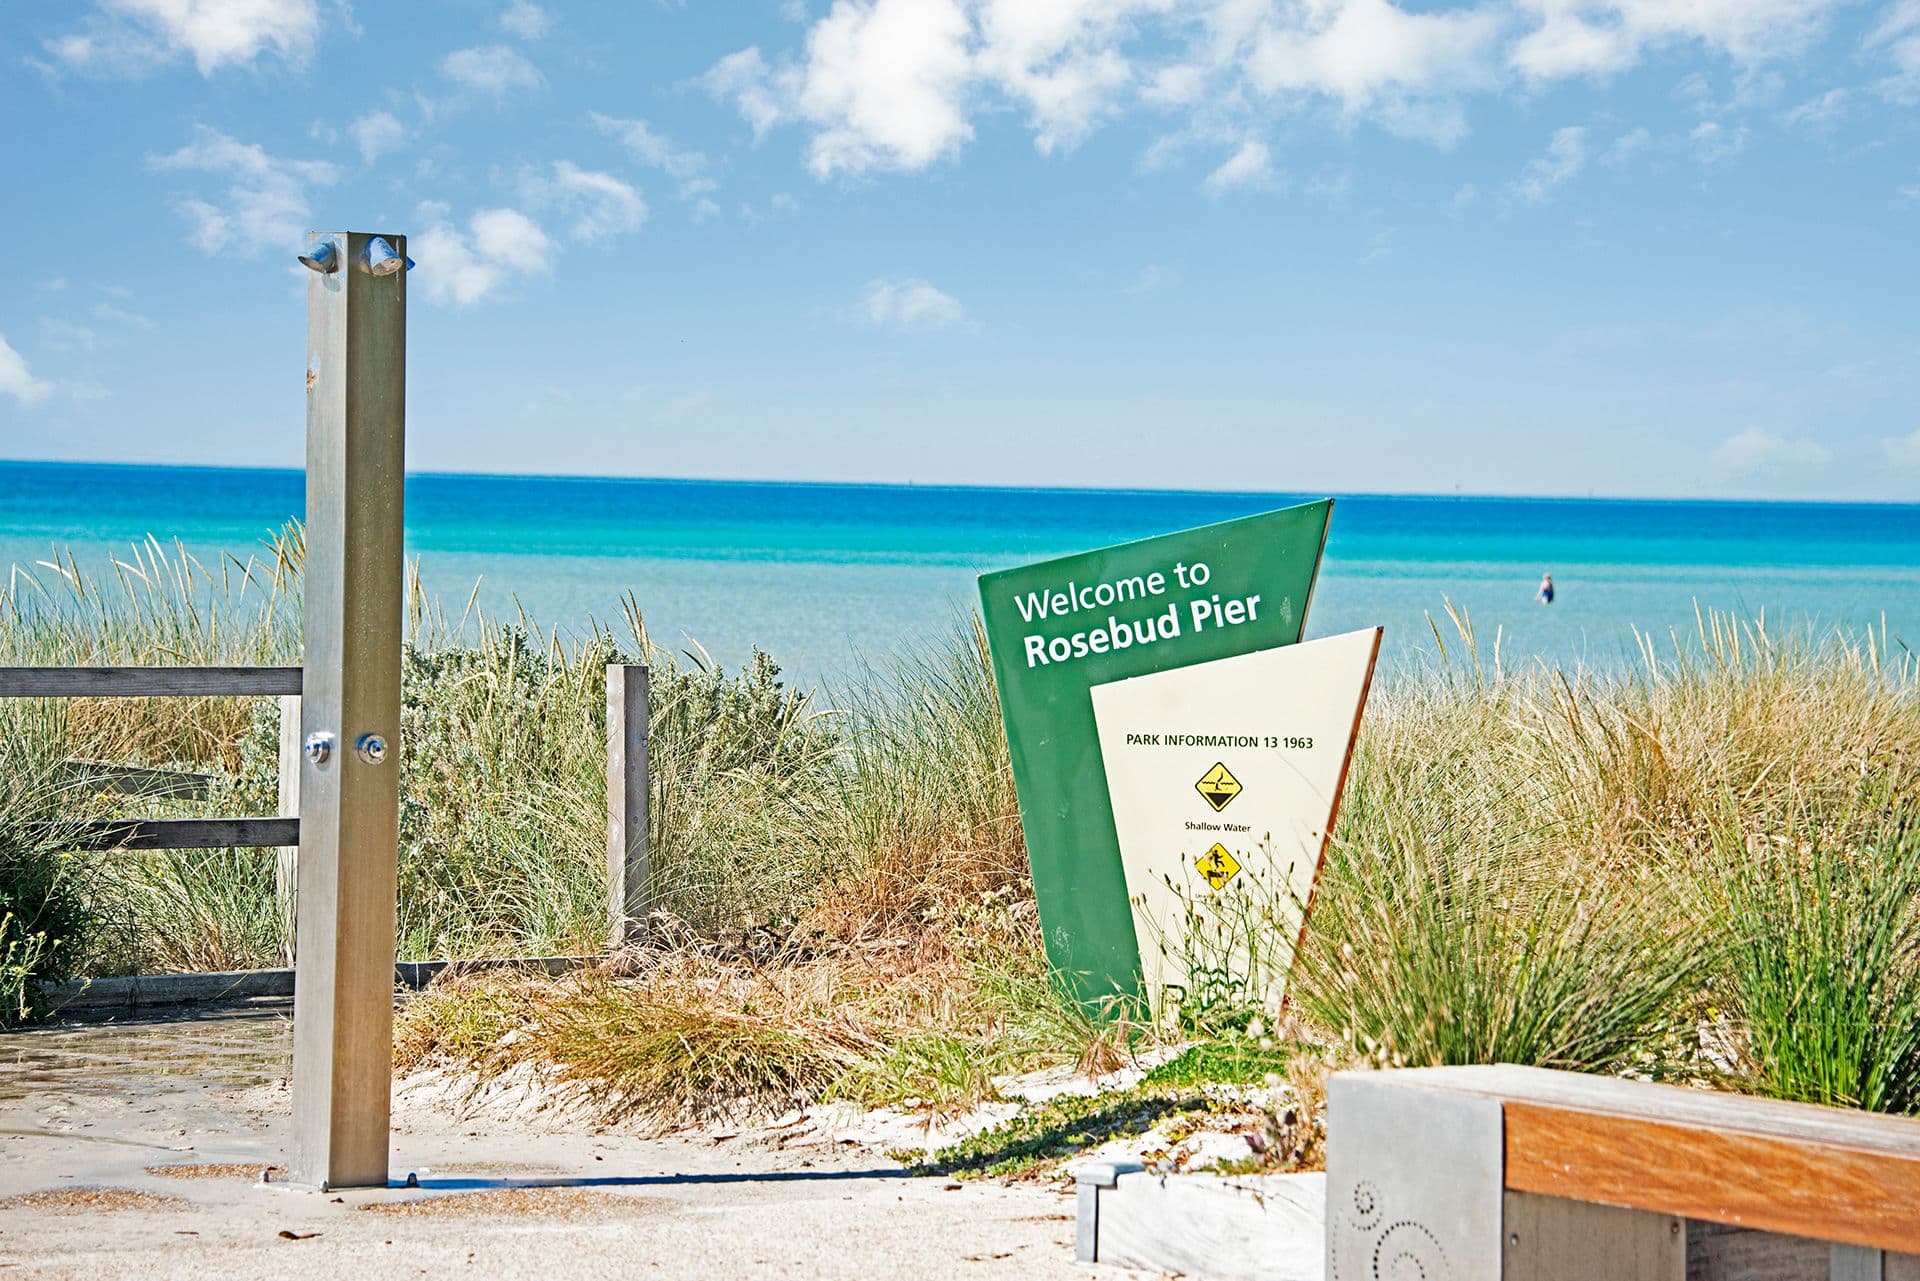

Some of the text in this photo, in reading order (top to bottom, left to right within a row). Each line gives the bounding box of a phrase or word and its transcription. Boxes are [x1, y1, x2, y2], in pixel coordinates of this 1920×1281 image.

[1014, 562, 1211, 623] Welcome to
[1023, 594, 1261, 668] Rosebud Pier
[1126, 733, 1314, 749] PARK INFORMATION 13 1963
[1184, 821, 1252, 833] Shallow Water
